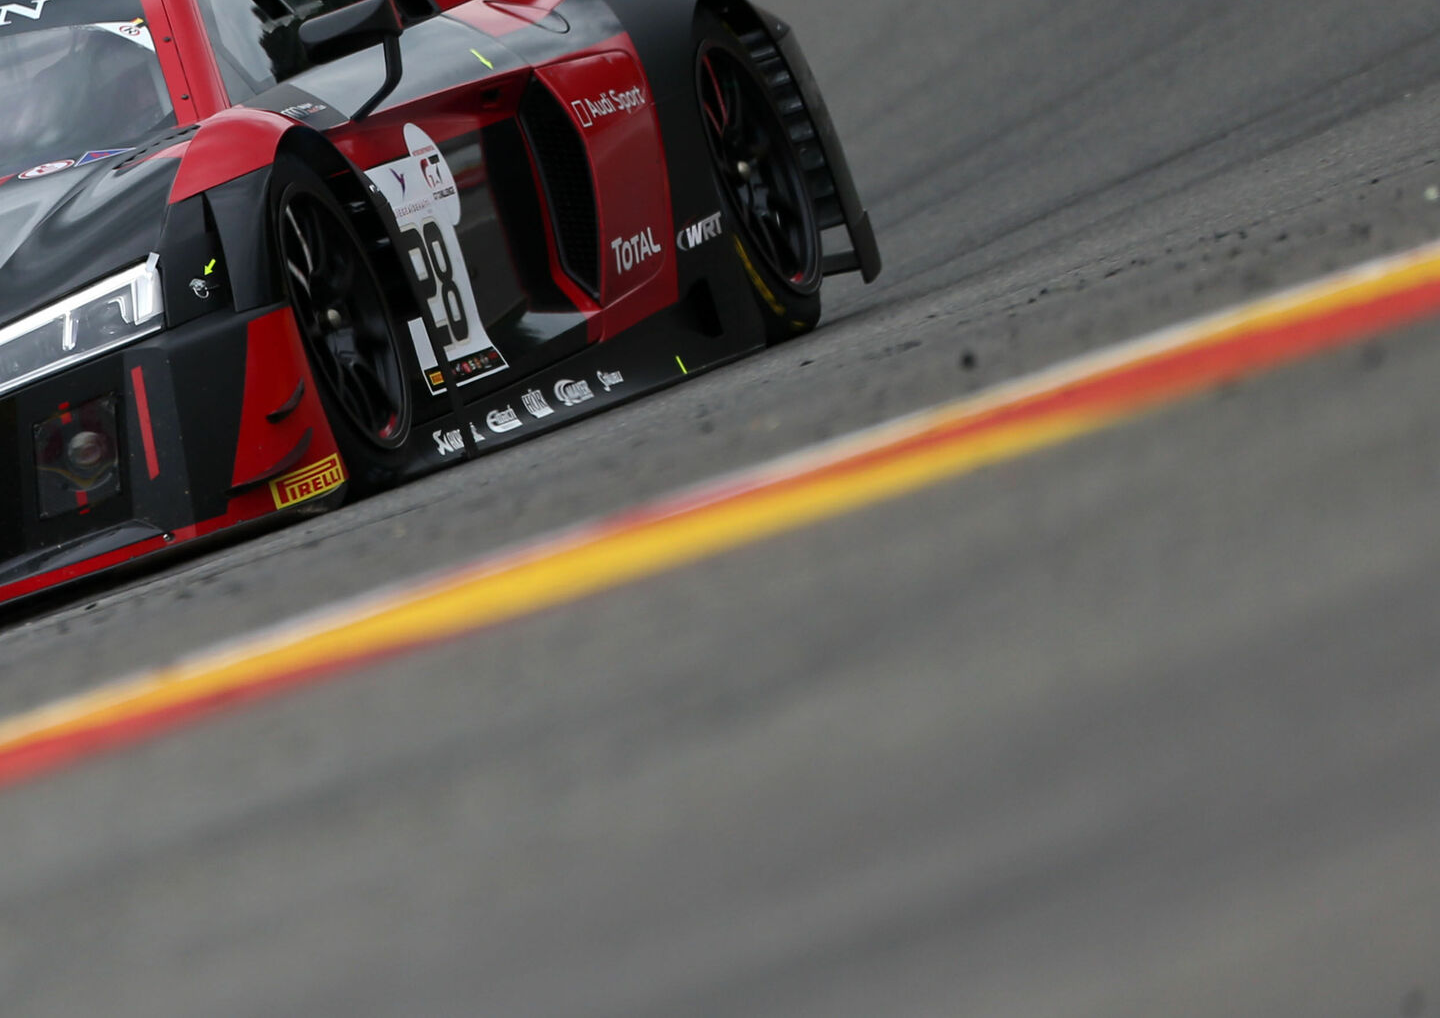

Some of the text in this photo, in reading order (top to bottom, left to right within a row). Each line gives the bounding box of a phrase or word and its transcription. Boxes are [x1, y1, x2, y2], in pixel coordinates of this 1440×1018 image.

[584, 85, 646, 118] Audi Sport
[611, 226, 662, 275] TOTAL
[685, 210, 723, 249] WRT
[275, 457, 343, 505] PIRELLI
